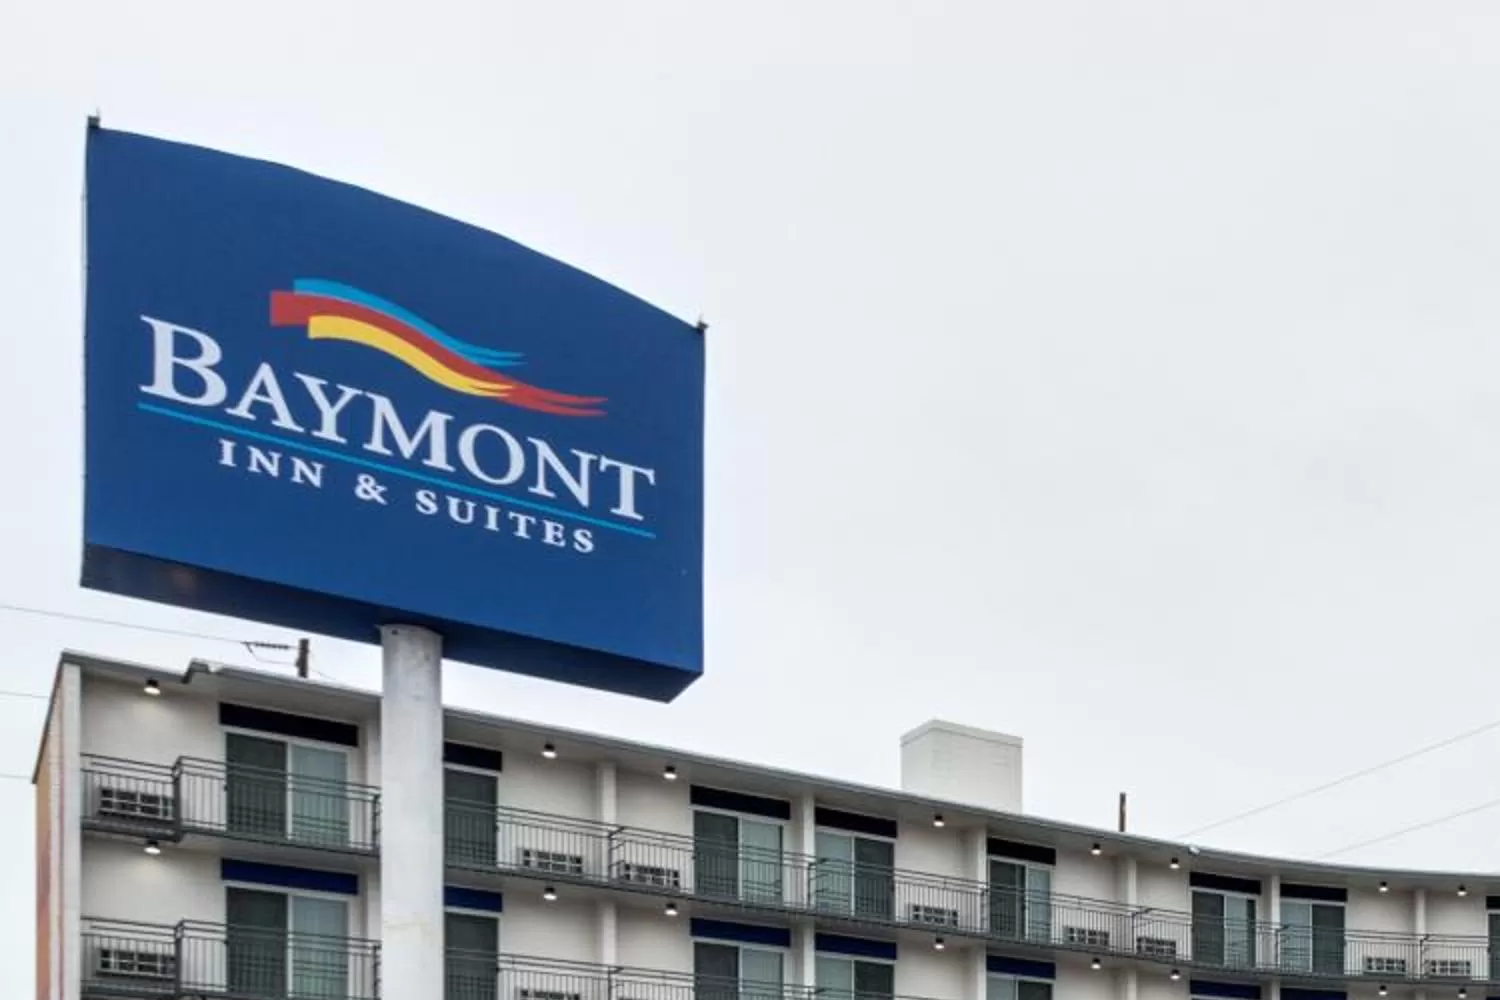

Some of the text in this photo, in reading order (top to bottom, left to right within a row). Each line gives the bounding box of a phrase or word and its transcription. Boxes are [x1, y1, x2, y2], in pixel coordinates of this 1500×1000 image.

[140, 315, 655, 521] BAYMONT
[219, 439, 594, 553] INN & SUITES
